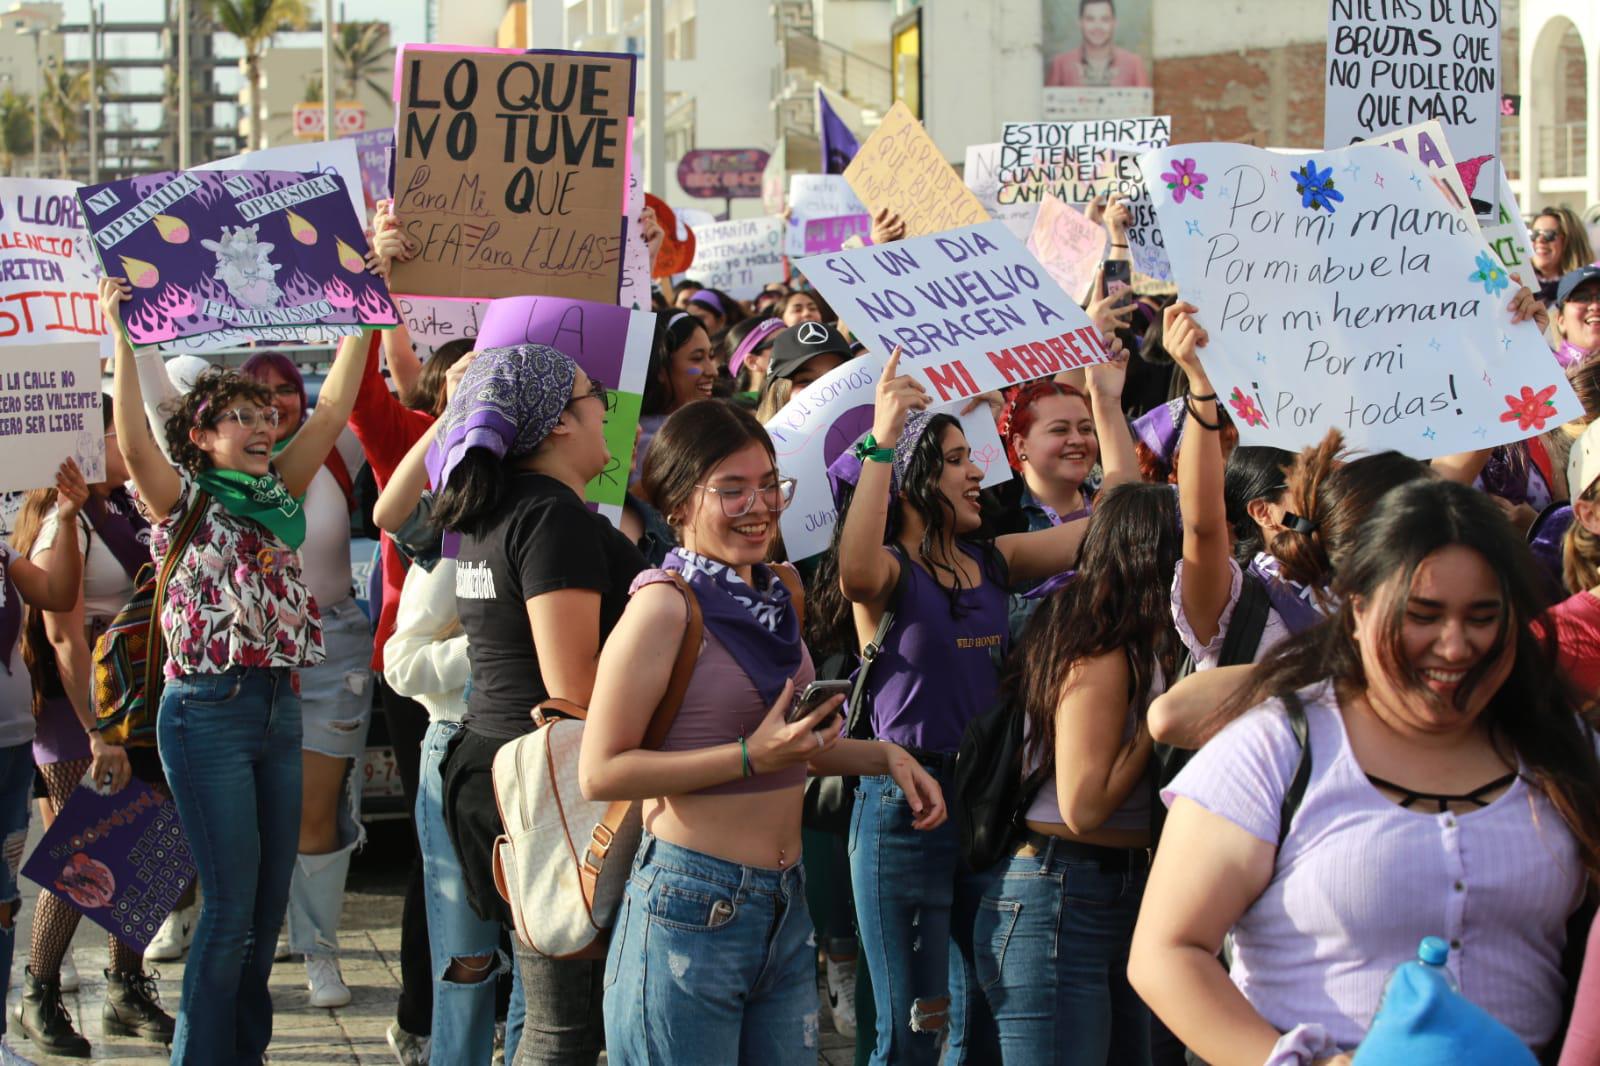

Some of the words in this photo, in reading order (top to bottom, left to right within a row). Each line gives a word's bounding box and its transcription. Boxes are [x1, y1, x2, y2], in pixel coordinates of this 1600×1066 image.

[1332, 0, 1421, 21] NIETAS
[1430, 0, 1456, 23] DE
[1461, 0, 1497, 28] LAS
[1335, 25, 1442, 58] BRUJAS
[1453, 33, 1493, 64] QUE
[407, 58, 479, 111] LO
[496, 60, 611, 116] QUE
[1329, 59, 1361, 89] NO
[1370, 60, 1495, 93] PUDIERON
[1003, 124, 1073, 146] ESTOY
[1084, 118, 1169, 144] HARTA
[1357, 92, 1477, 132] QUEMAR
[404, 111, 478, 161] NO
[495, 113, 619, 168] TUVE
[1001, 145, 1033, 169] DE
[89, 189, 117, 212] NI
[225, 177, 251, 197] NI
[98, 174, 199, 247] OPRIMIDA
[238, 177, 337, 220] OPRESORA
[400, 165, 447, 212] Para
[504, 166, 579, 216] QUE
[1224, 164, 1286, 233] Por
[1295, 211, 1335, 245] mi
[17, 195, 88, 230] LLORE
[0, 231, 73, 258] LENCIO
[404, 220, 463, 266] SEA
[826, 257, 866, 289] SI
[875, 246, 920, 279] UN
[936, 231, 999, 264] DIA
[1205, 233, 1256, 284] Por
[1265, 258, 1299, 284] mi
[1307, 245, 1432, 283] abuela
[204, 301, 333, 326] FEMINISMO
[856, 290, 912, 323] NO
[916, 264, 1040, 311] VUELVO
[1220, 292, 1267, 334] Por
[1282, 306, 1322, 332] mi
[1332, 292, 1480, 328] hermana
[525, 298, 584, 354] LA
[878, 303, 1027, 361] ABRACEN
[1038, 298, 1065, 327] A
[1304, 340, 1355, 376] Por
[1366, 343, 1404, 374] mi
[7, 371, 21, 390] LA
[23, 371, 57, 389] CALLE
[60, 370, 76, 388] NO
[922, 360, 980, 401] MI
[24, 393, 45, 412] SER
[1344, 374, 1464, 428] todas!
[25, 415, 46, 434] SER
[49, 412, 84, 432] LIBRE
